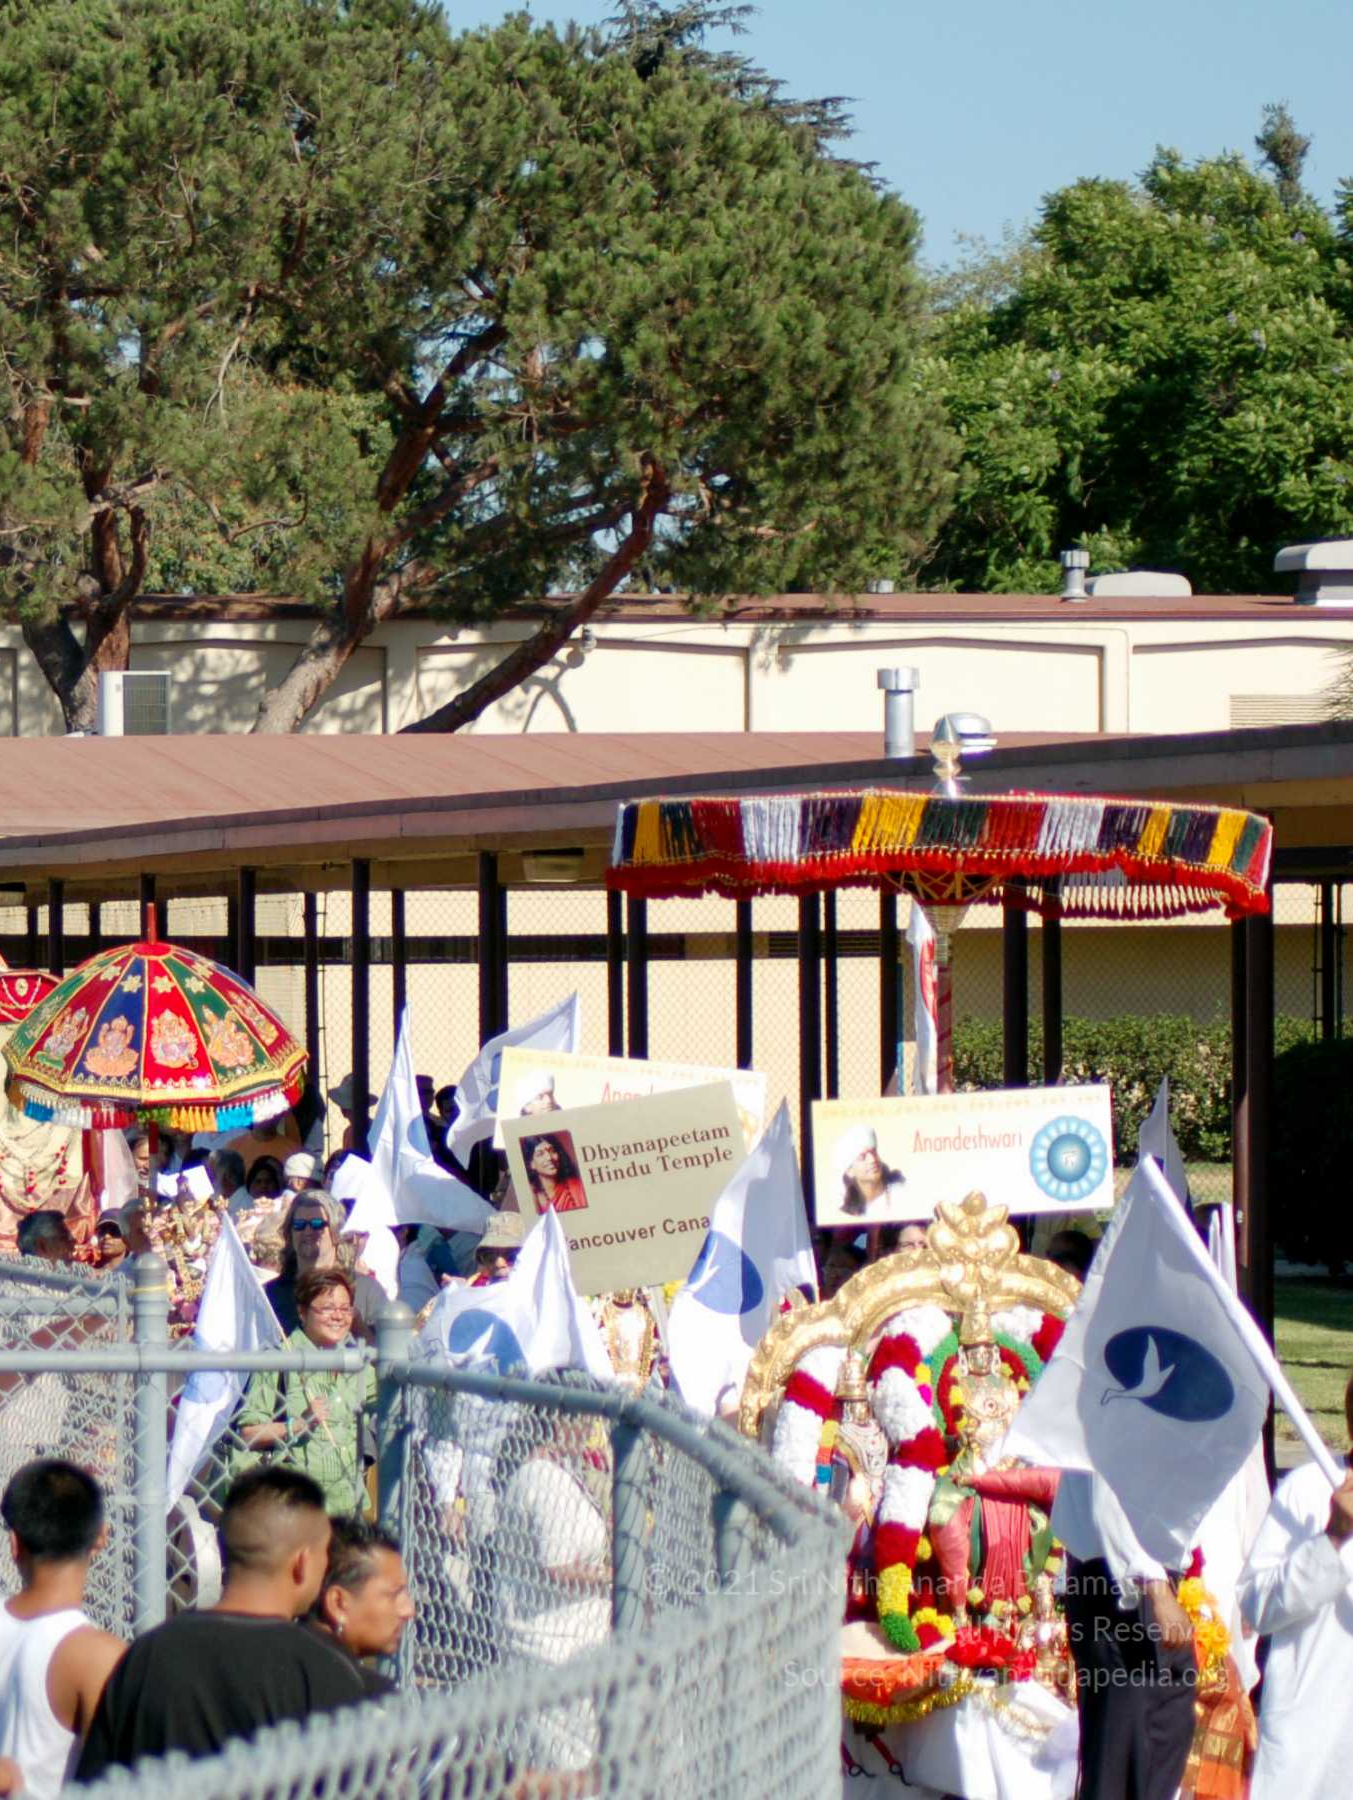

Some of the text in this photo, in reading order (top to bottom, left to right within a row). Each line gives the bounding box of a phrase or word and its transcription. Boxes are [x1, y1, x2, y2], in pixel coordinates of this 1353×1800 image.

[581, 1126, 730, 1163] Dhyanapeetam
[913, 1125, 1022, 1153] Anandeshwari
[588, 1147, 733, 1185] Hindu Temple
[566, 1225, 657, 1251] ancouver
